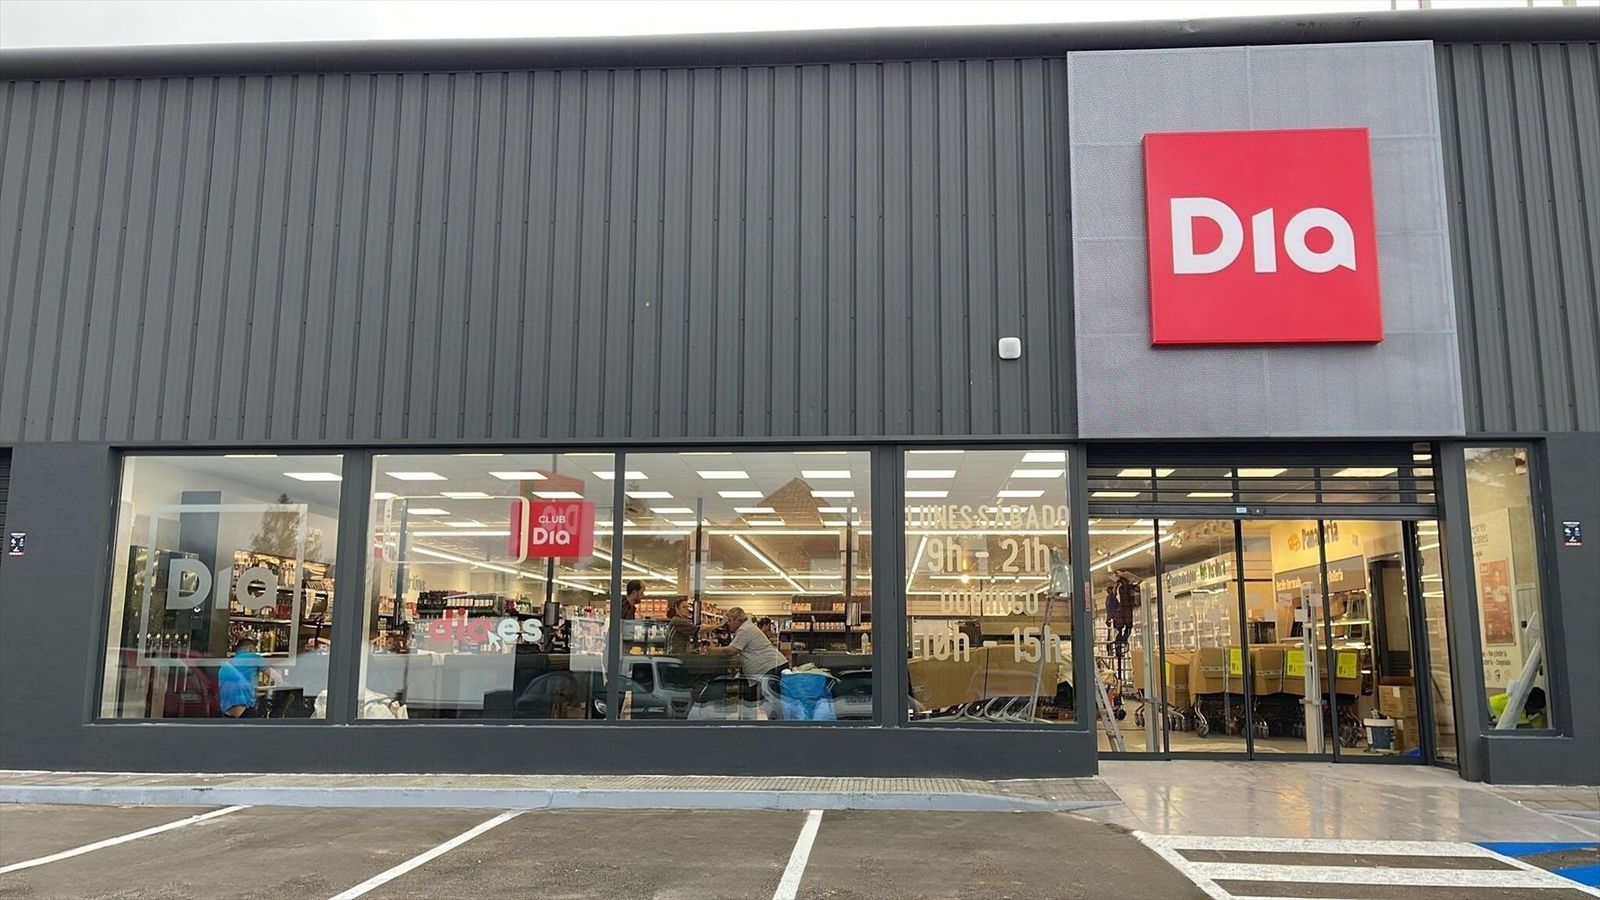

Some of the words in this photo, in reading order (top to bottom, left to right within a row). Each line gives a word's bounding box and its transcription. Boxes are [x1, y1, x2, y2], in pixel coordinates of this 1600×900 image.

[538, 515, 566, 524] CLUB
[927, 536, 962, 572] 9h
[999, 536, 1050, 573] 21h
[940, 588, 1039, 616] DOMINGO
[922, 624, 970, 663] 10h
[1011, 624, 1062, 664] 15h
